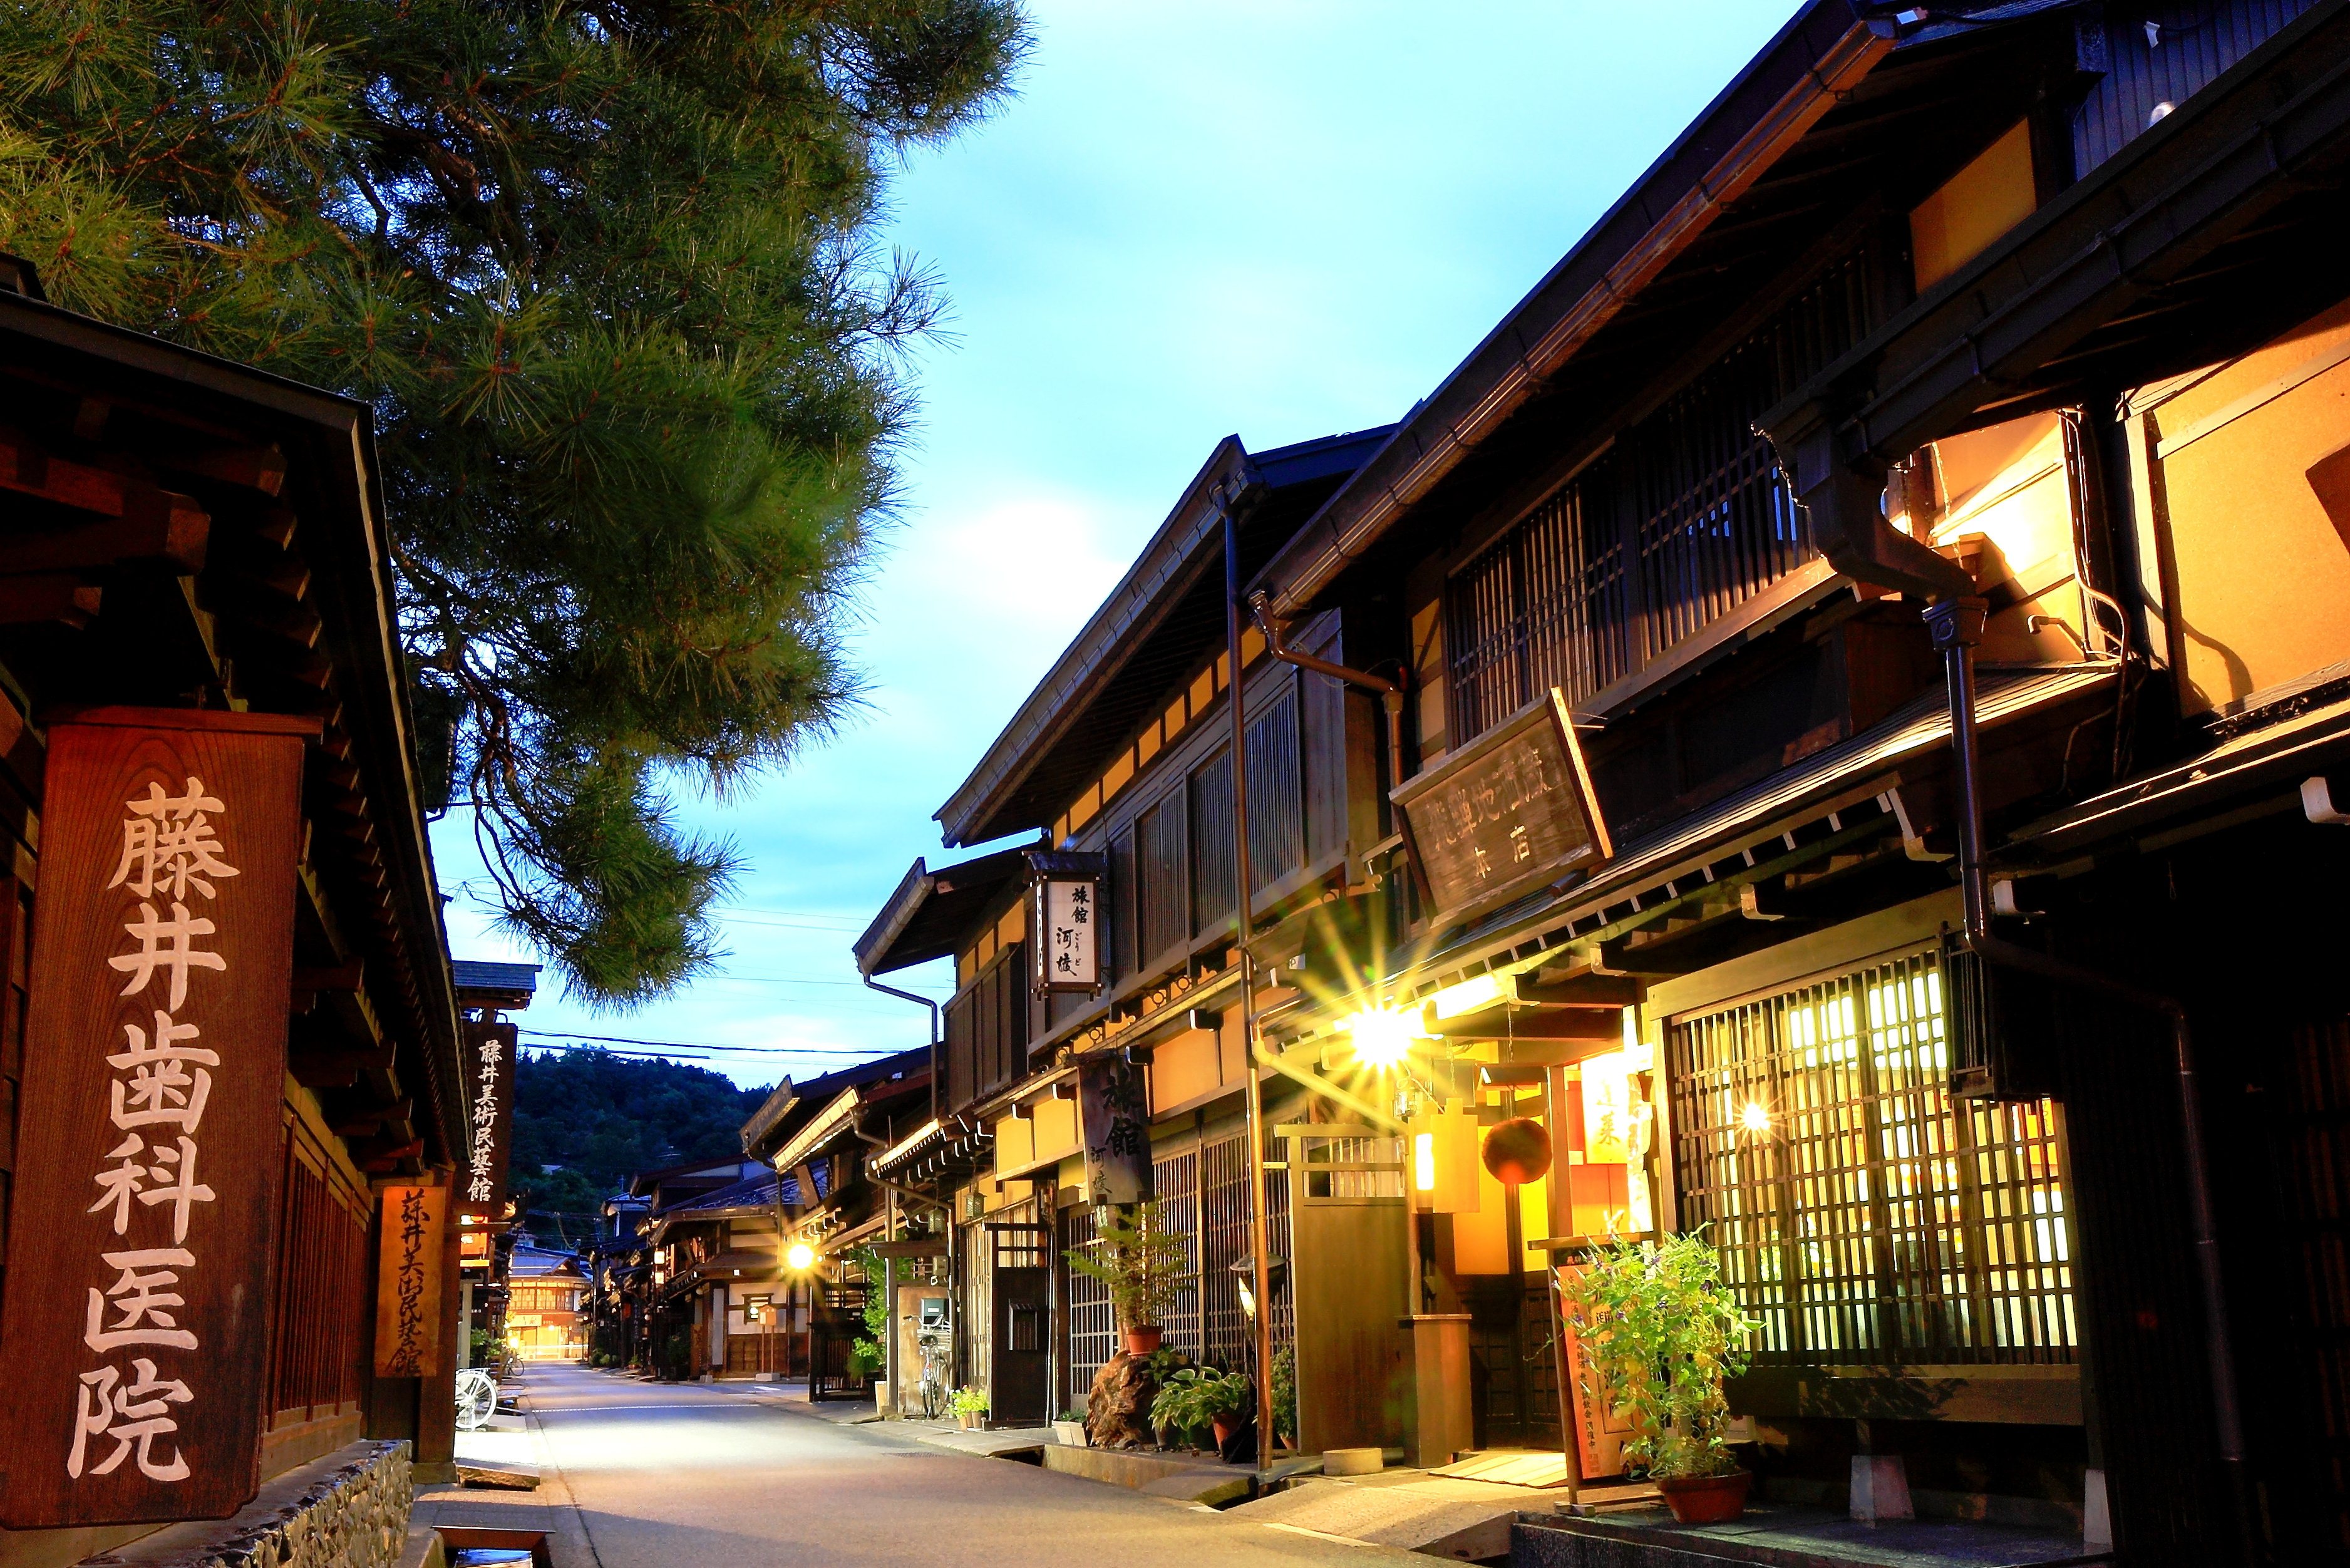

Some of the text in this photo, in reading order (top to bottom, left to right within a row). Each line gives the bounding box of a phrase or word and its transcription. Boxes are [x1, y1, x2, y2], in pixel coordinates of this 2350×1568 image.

[1071, 885, 1090, 924] 旅館
[1075, 932, 1083, 966] ごうど
[66, 776, 240, 1481] 藤井歯科医院
[467, 1039, 502, 1202] 藤井美術民藝館
